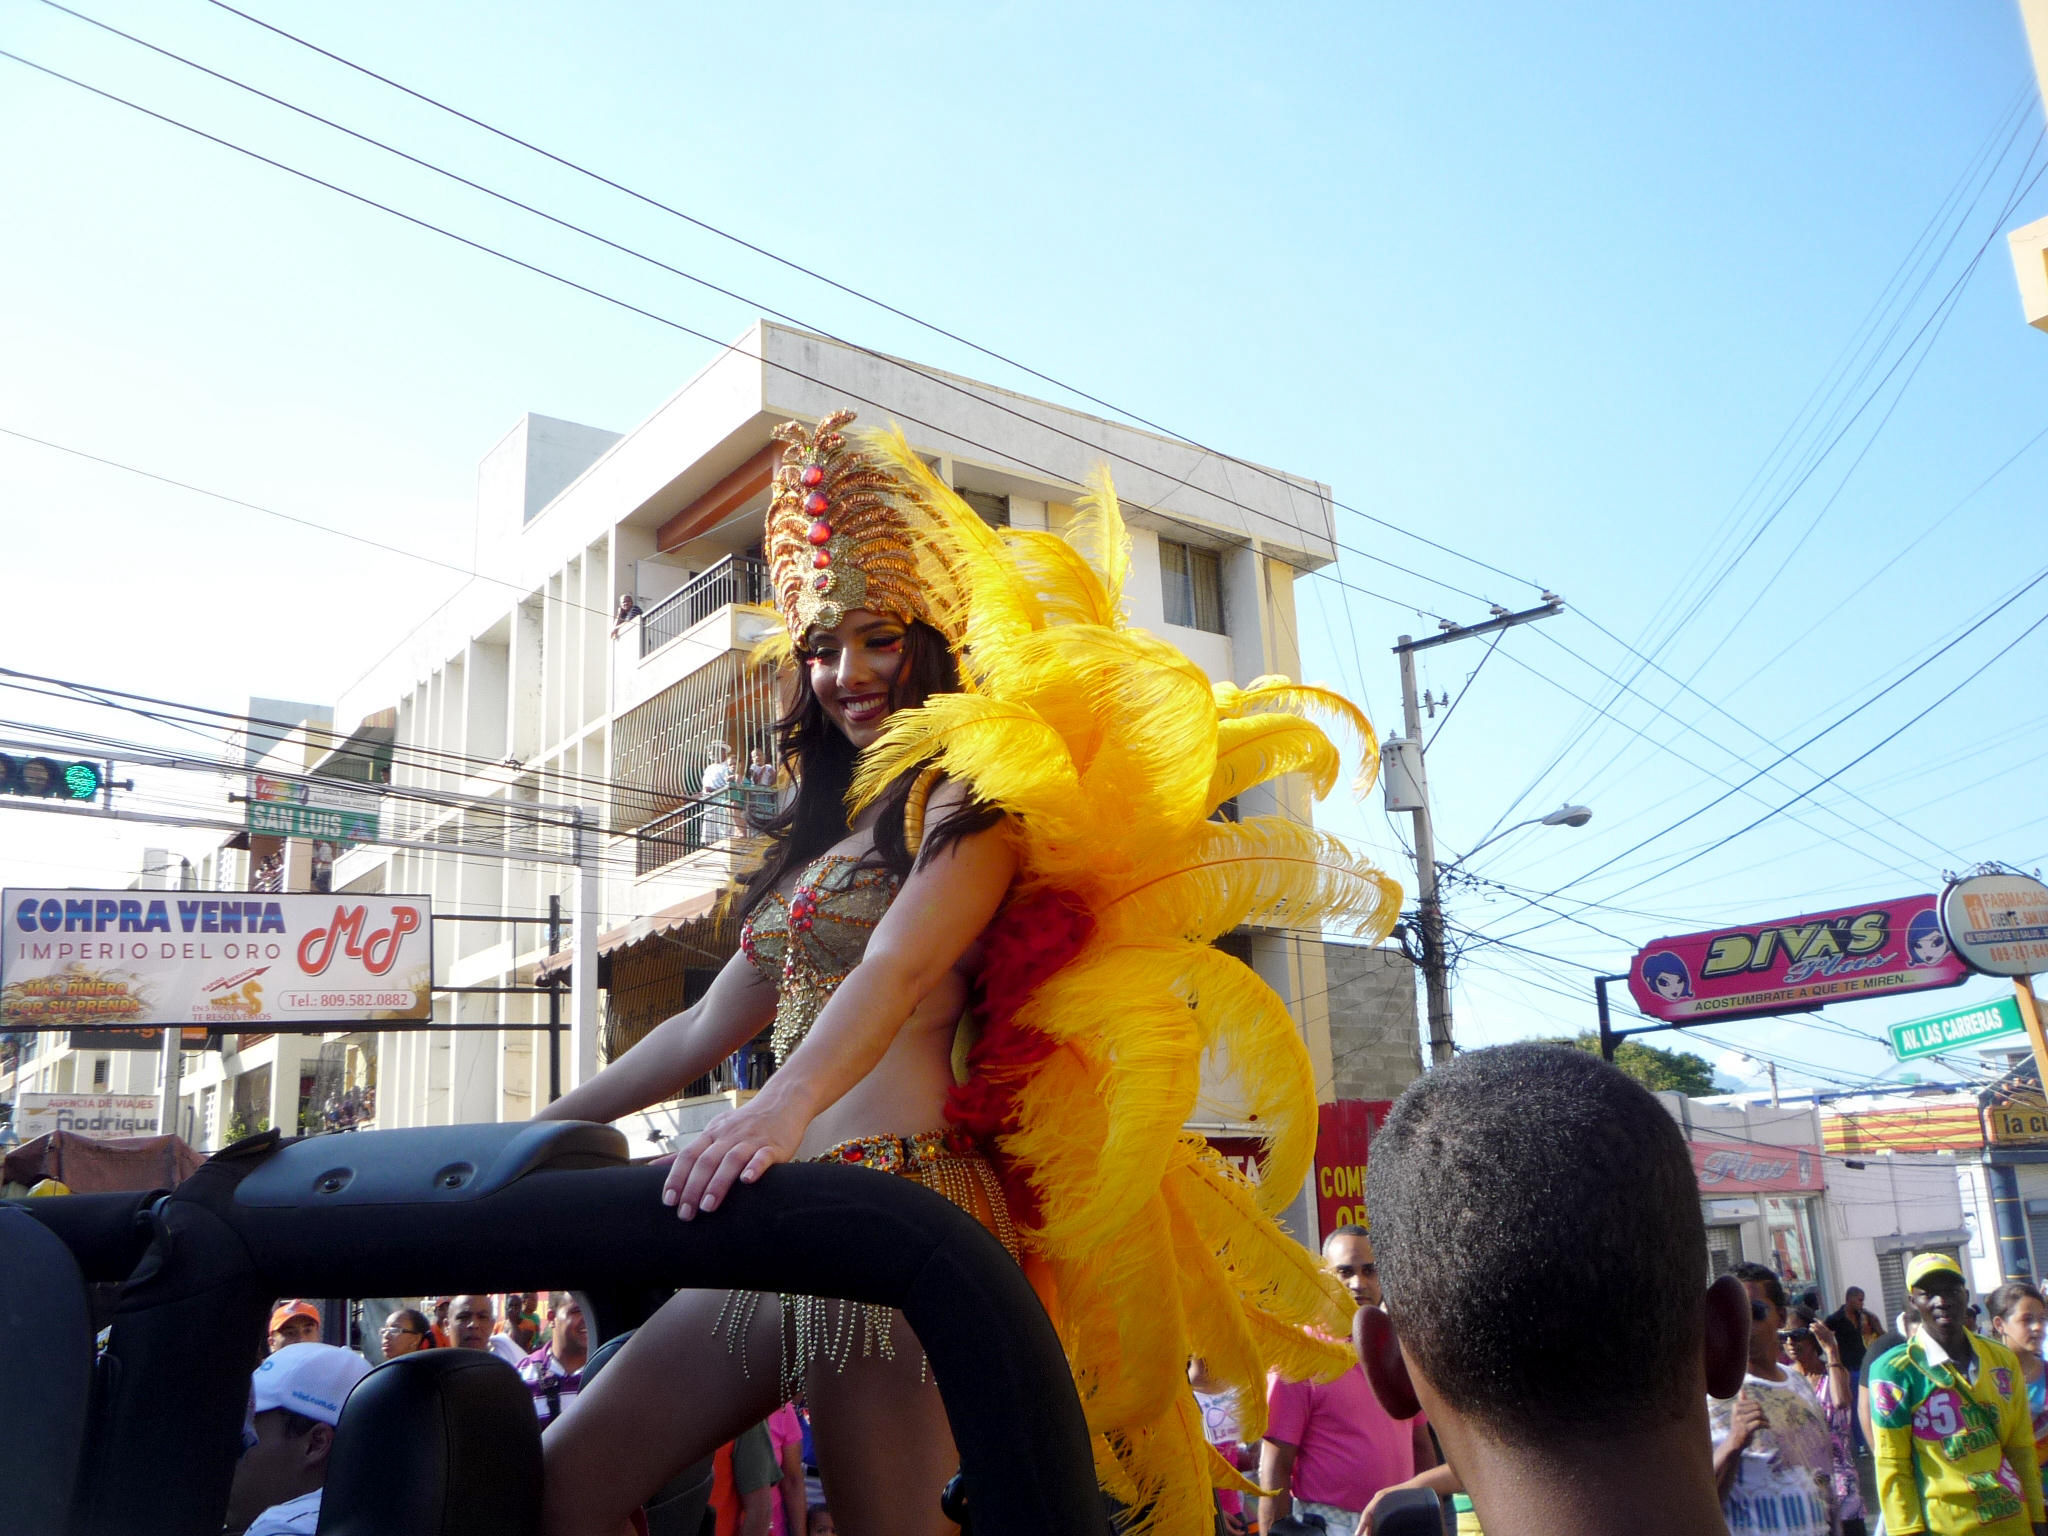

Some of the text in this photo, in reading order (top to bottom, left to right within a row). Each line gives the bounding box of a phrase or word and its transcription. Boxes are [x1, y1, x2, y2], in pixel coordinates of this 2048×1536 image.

[253, 805, 341, 836] SAN LUIS
[1983, 892, 2047, 907] FARMACIAS
[17, 898, 286, 933] COMPRA VENTA
[2023, 911, 2037, 925] SAN
[20, 943, 281, 959] IMPERIO DEL ORO
[1701, 911, 1890, 978] DIVA'S
[1783, 952, 1899, 983] Plus
[25, 982, 128, 996] MAS DINERO
[1695, 989, 1794, 1012] ACOSTUMBRATE
[1799, 987, 1809, 998] A
[1812, 983, 1838, 996] QUE
[1843, 981, 1859, 991] TE
[8, 1000, 140, 1015] POR SU PRENDA
[320, 994, 408, 1008] 809.582.0882
[206, 1012, 272, 1021] RESOLVEMOS
[1902, 1008, 2003, 1051] AV. LAS CARRERAS
[48, 1098, 154, 1110] AGENCIA DE VIAJES
[56, 1109, 158, 1136] Rodrigue
[2003, 1113, 2025, 1134] la
